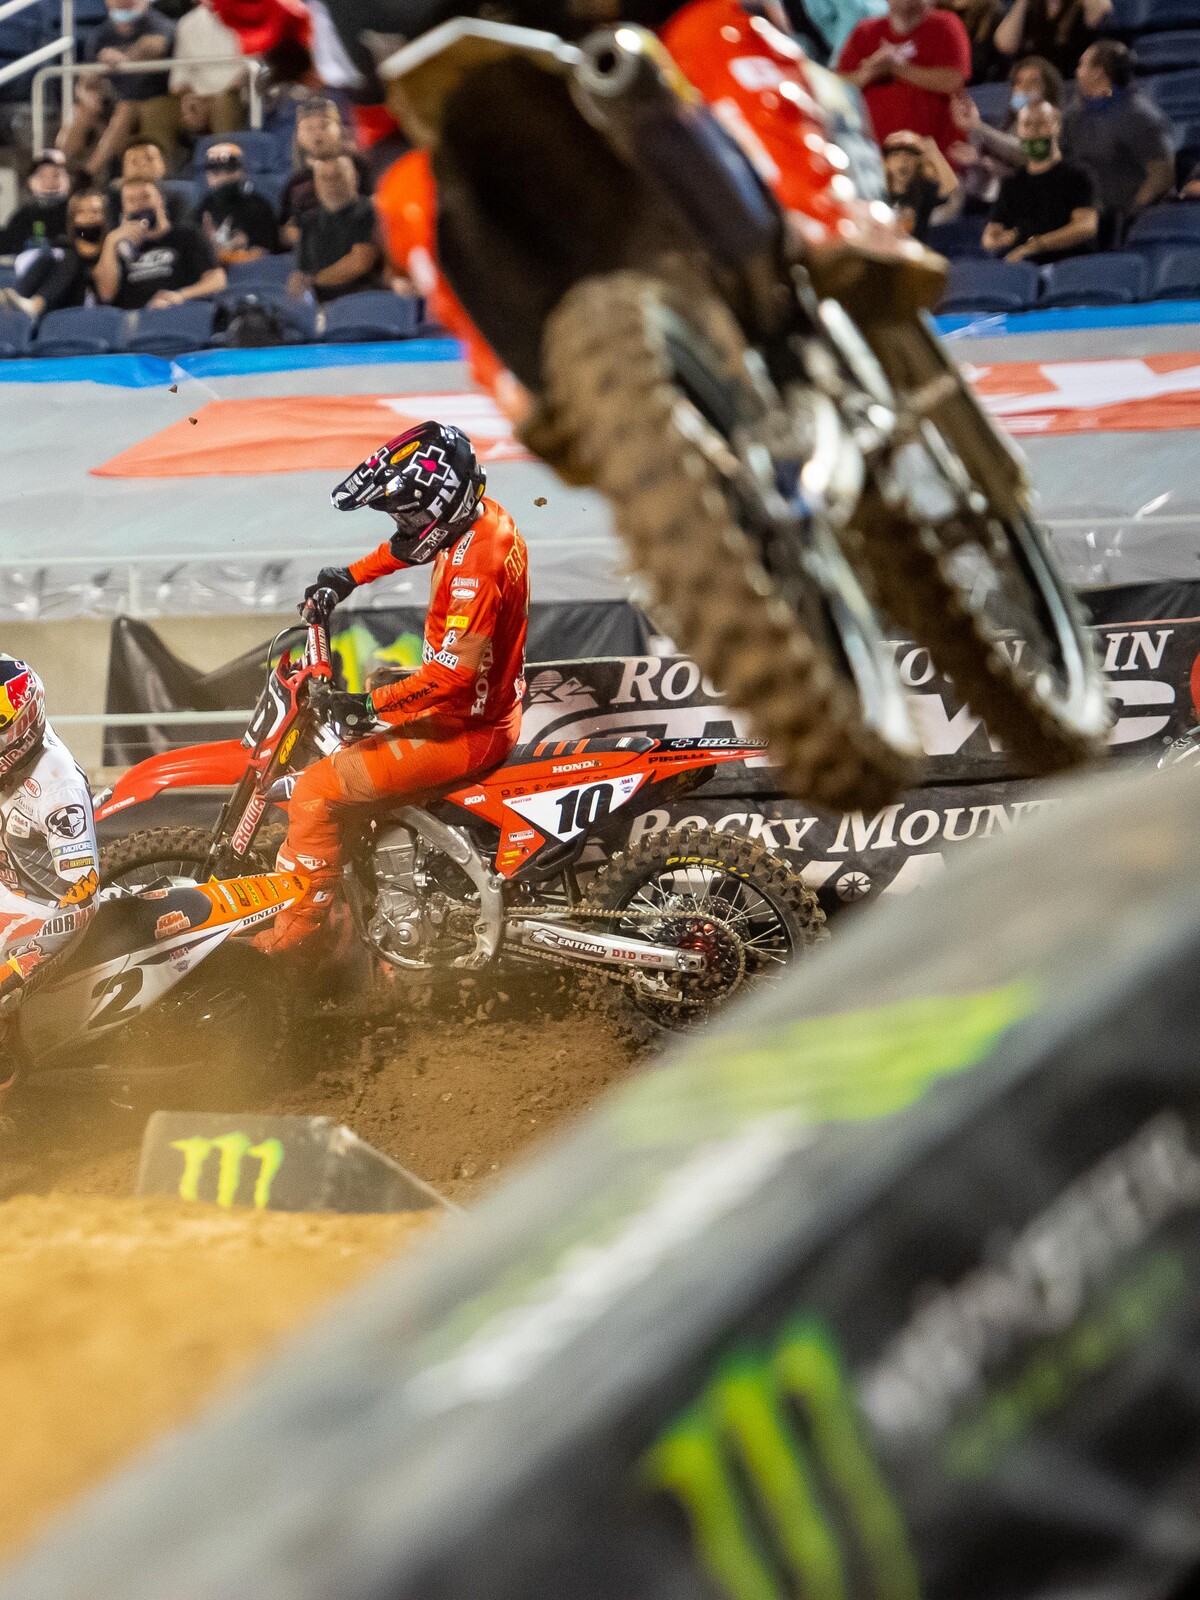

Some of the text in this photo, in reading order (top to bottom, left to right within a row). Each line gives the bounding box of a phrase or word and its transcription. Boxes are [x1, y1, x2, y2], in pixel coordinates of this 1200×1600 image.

[427, 469, 461, 518] FLY
[318, 627, 328, 662] RENTHAL
[648, 753, 704, 764] PIRELLI
[25, 780, 40, 796] BELL
[233, 798, 266, 855] SHOWA
[556, 783, 614, 835] 10
[243, 902, 285, 926] DUNLOP
[530, 928, 607, 954] RENTHAL
[91, 967, 144, 1031] 2
